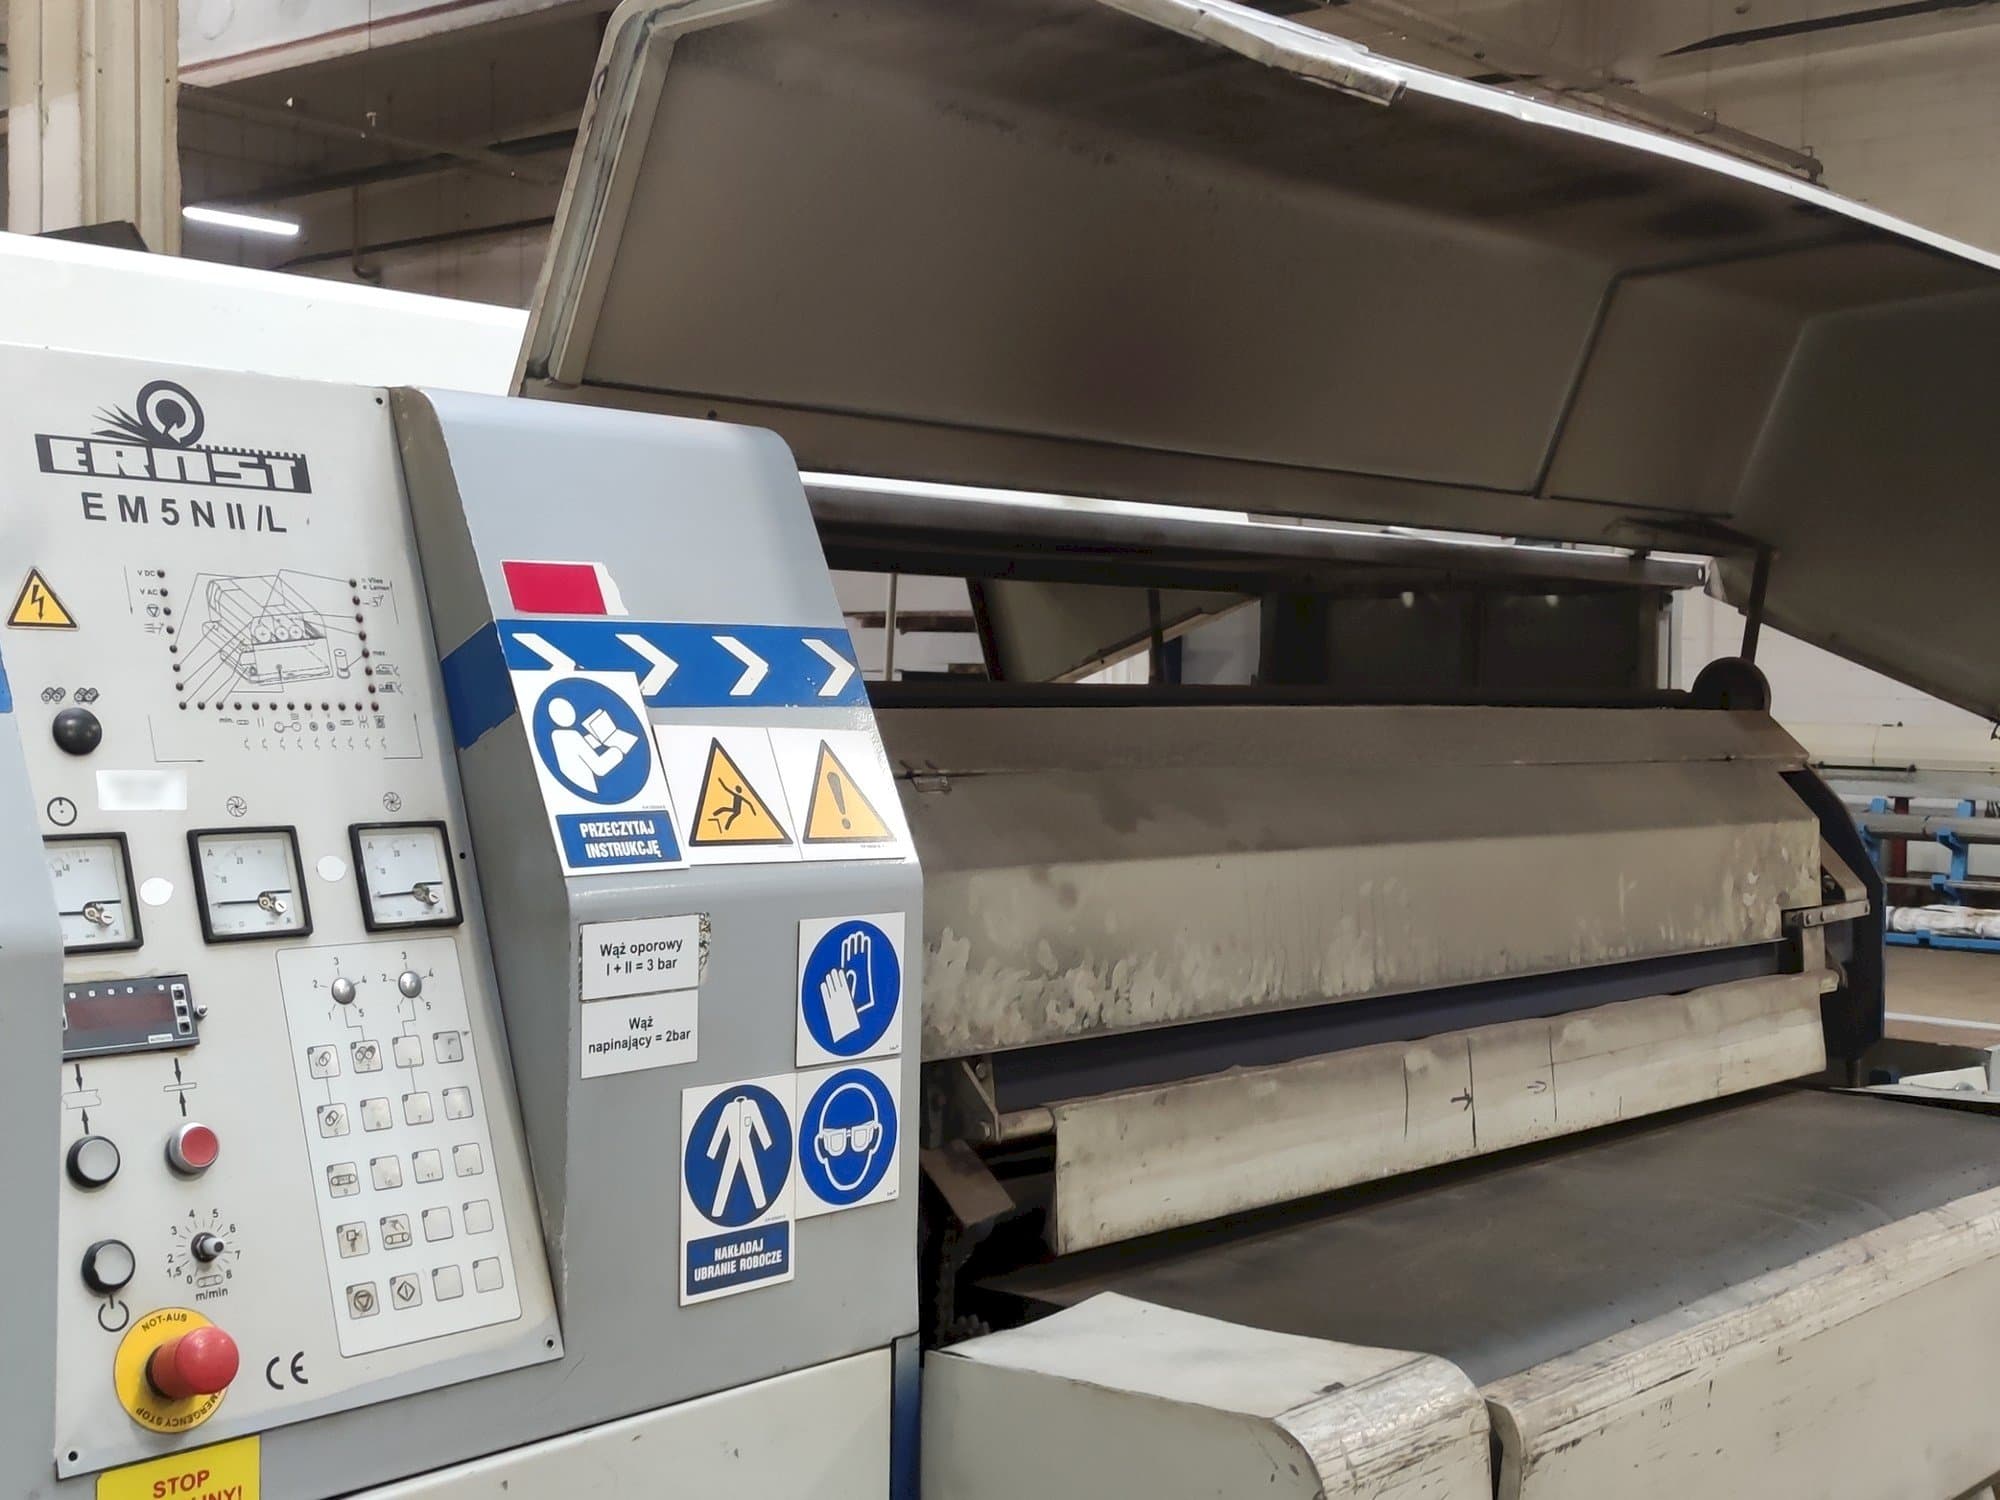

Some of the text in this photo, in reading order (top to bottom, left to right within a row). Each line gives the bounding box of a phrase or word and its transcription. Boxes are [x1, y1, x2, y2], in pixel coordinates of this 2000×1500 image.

[48, 437, 298, 491] ERNST
[579, 819, 656, 839] PRZECZYTAJ
[585, 839, 663, 859] INSTRUKCJĘ
[600, 938, 684, 959] Wąż oporowy
[625, 961, 633, 975] II
[647, 958, 655, 972] 3
[658, 957, 678, 971] bar
[628, 1015, 654, 1032] Wąż
[588, 1036, 653, 1055] napinający
[665, 1029, 692, 1043] 2bar
[188, 1208, 195, 1219] 4
[212, 1208, 219, 1219] 5
[170, 1225, 178, 1236] 3
[229, 1223, 236, 1234] 6
[167, 1253, 174, 1264] 2
[234, 1249, 241, 1260] 7
[714, 1237, 764, 1262] NAKŁADAJ
[225, 1269, 233, 1280] 8
[694, 1249, 783, 1282] UBRANIE ROBOCZE
[186, 1274, 193, 1285] 0
[195, 1287, 229, 1302] m/min
[141, 1312, 188, 1332] NOT-AUS
[164, 1391, 219, 1428] MERGENCY
[153, 1469, 210, 1499] STOP
